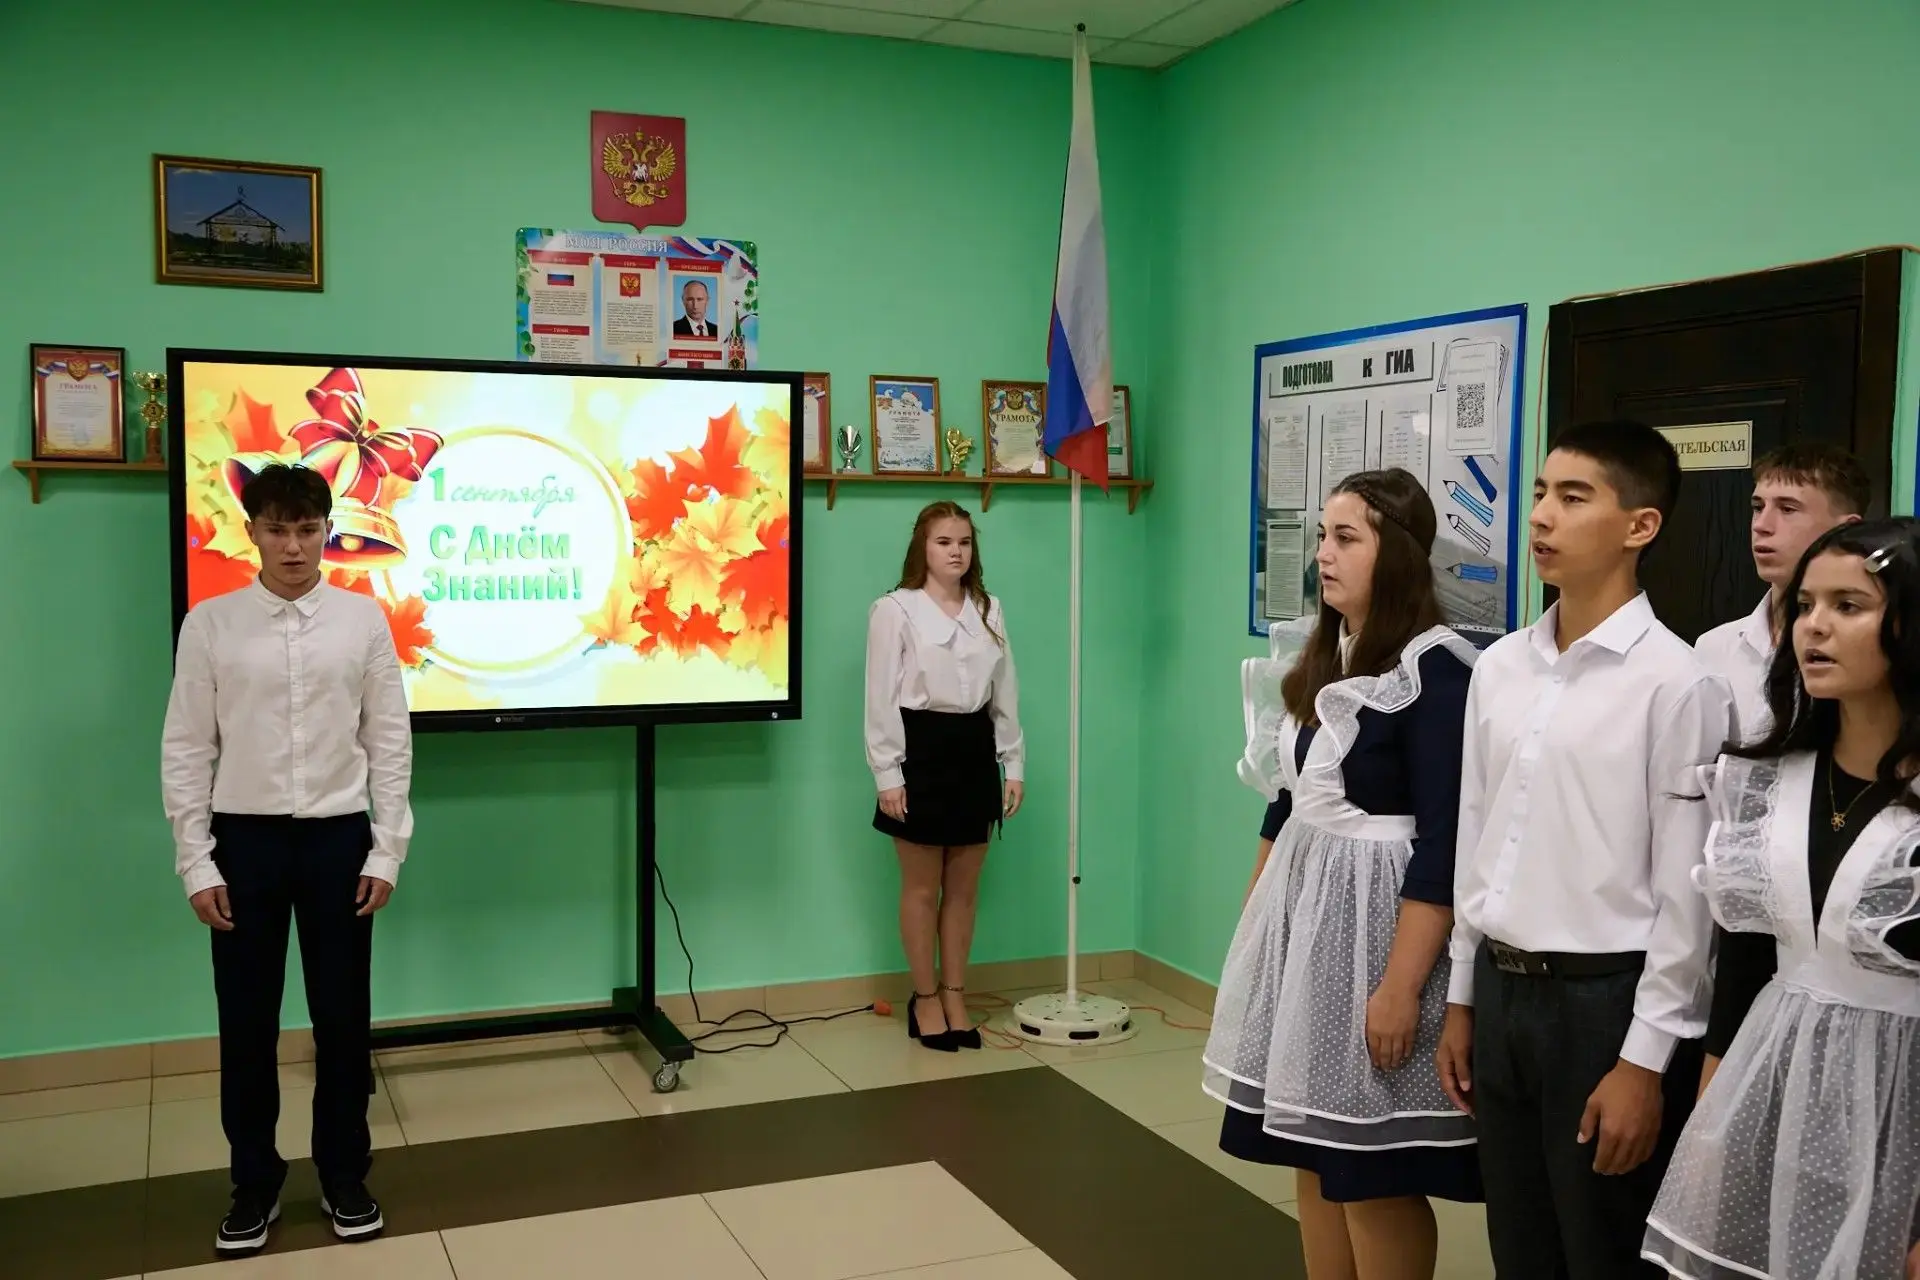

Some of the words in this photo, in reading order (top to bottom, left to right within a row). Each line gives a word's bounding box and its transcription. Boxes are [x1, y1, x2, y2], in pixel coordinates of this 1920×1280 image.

[1282, 359, 1334, 389] ПОДГОТОВКА
[1385, 348, 1415, 376] ГИА
[995, 413, 1037, 424] ГРАМОТА
[1674, 439, 1746, 454] ТЕЛЬСКАЯ
[428, 466, 445, 502] 1
[450, 475, 578, 518] сентября
[428, 525, 457, 558] С
[463, 524, 570, 566] Днём
[421, 566, 583, 602] Знаний!
